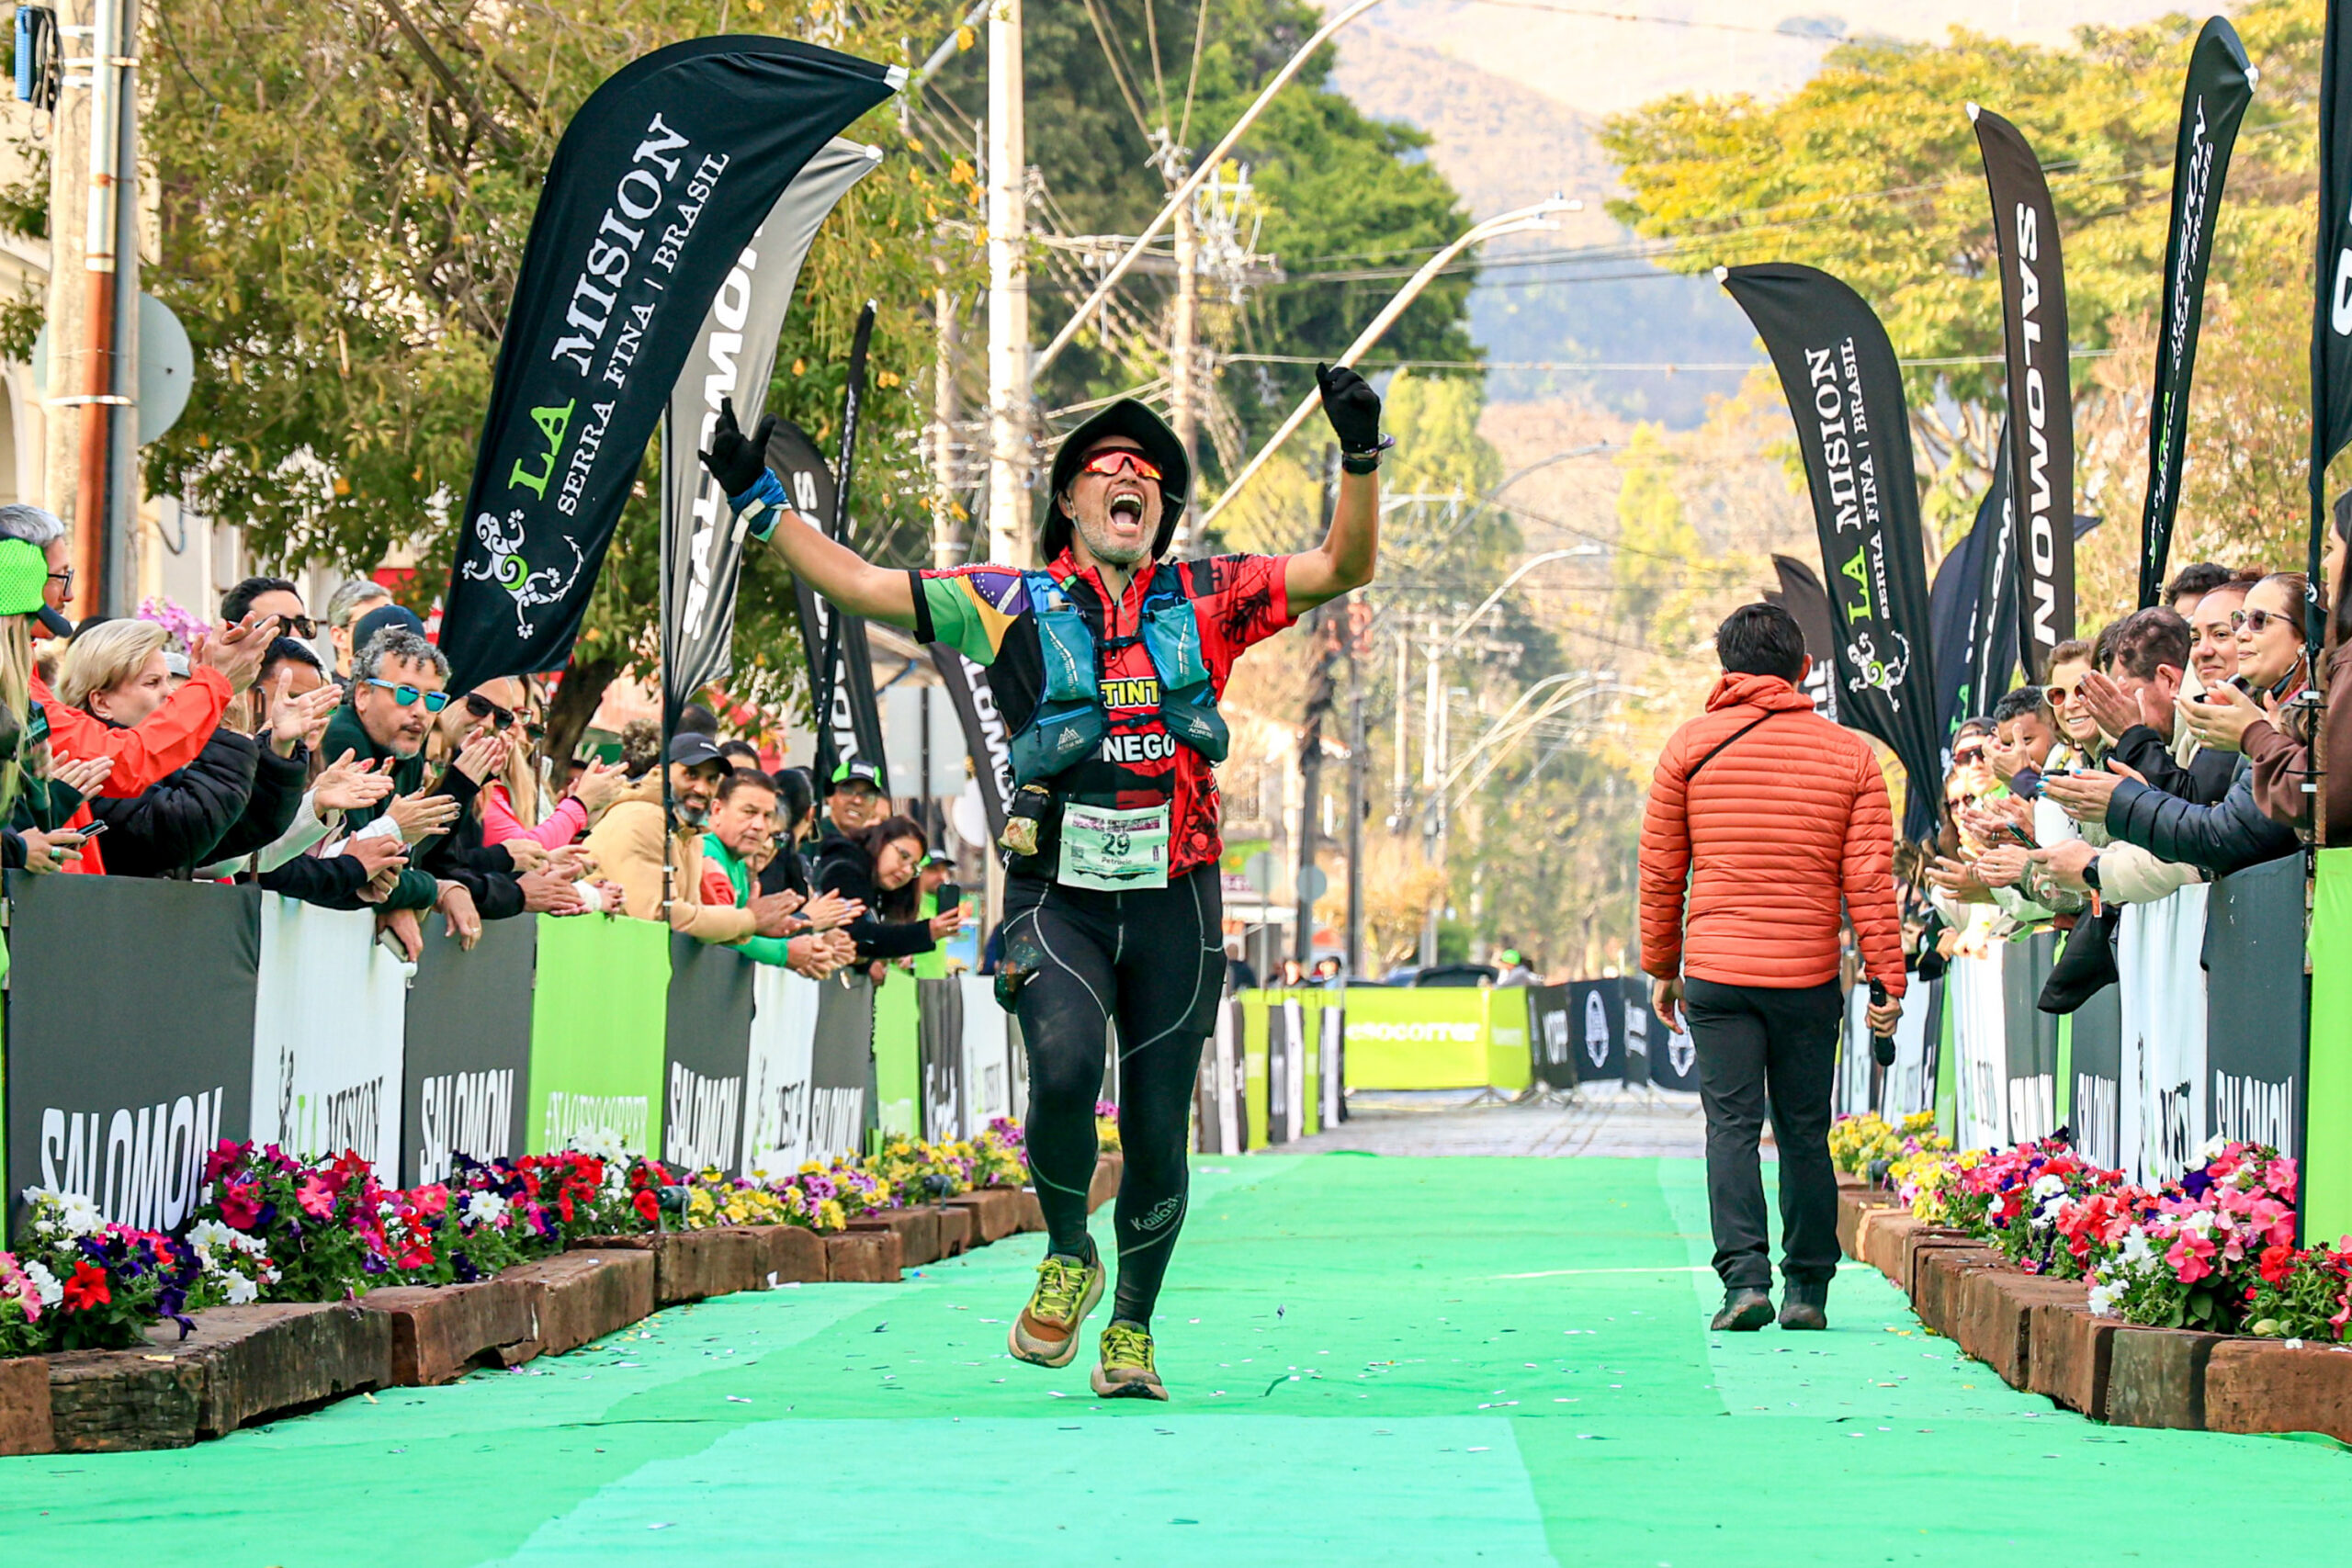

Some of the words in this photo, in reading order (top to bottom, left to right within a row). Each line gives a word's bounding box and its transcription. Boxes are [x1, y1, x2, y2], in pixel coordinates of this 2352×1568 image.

[508, 399, 577, 501] LA
[551, 112, 691, 378] MISION
[557, 400, 616, 517] SERRA
[603, 302, 656, 389] FINA
[651, 152, 730, 274] BRASIL
[1839, 335, 1869, 434] BRASIL
[2016, 201, 2057, 649] SALOMON
[1804, 346, 1862, 536] MISION
[1860, 454, 1883, 525] FINA
[1840, 546, 1874, 625] LA
[1871, 530, 1893, 621] SERRA
[1102, 732, 1176, 763] NEGO
[1101, 831, 1131, 856] 29
[41, 1086, 223, 1234] SALOMON
[421, 1067, 514, 1177] SALOMON
